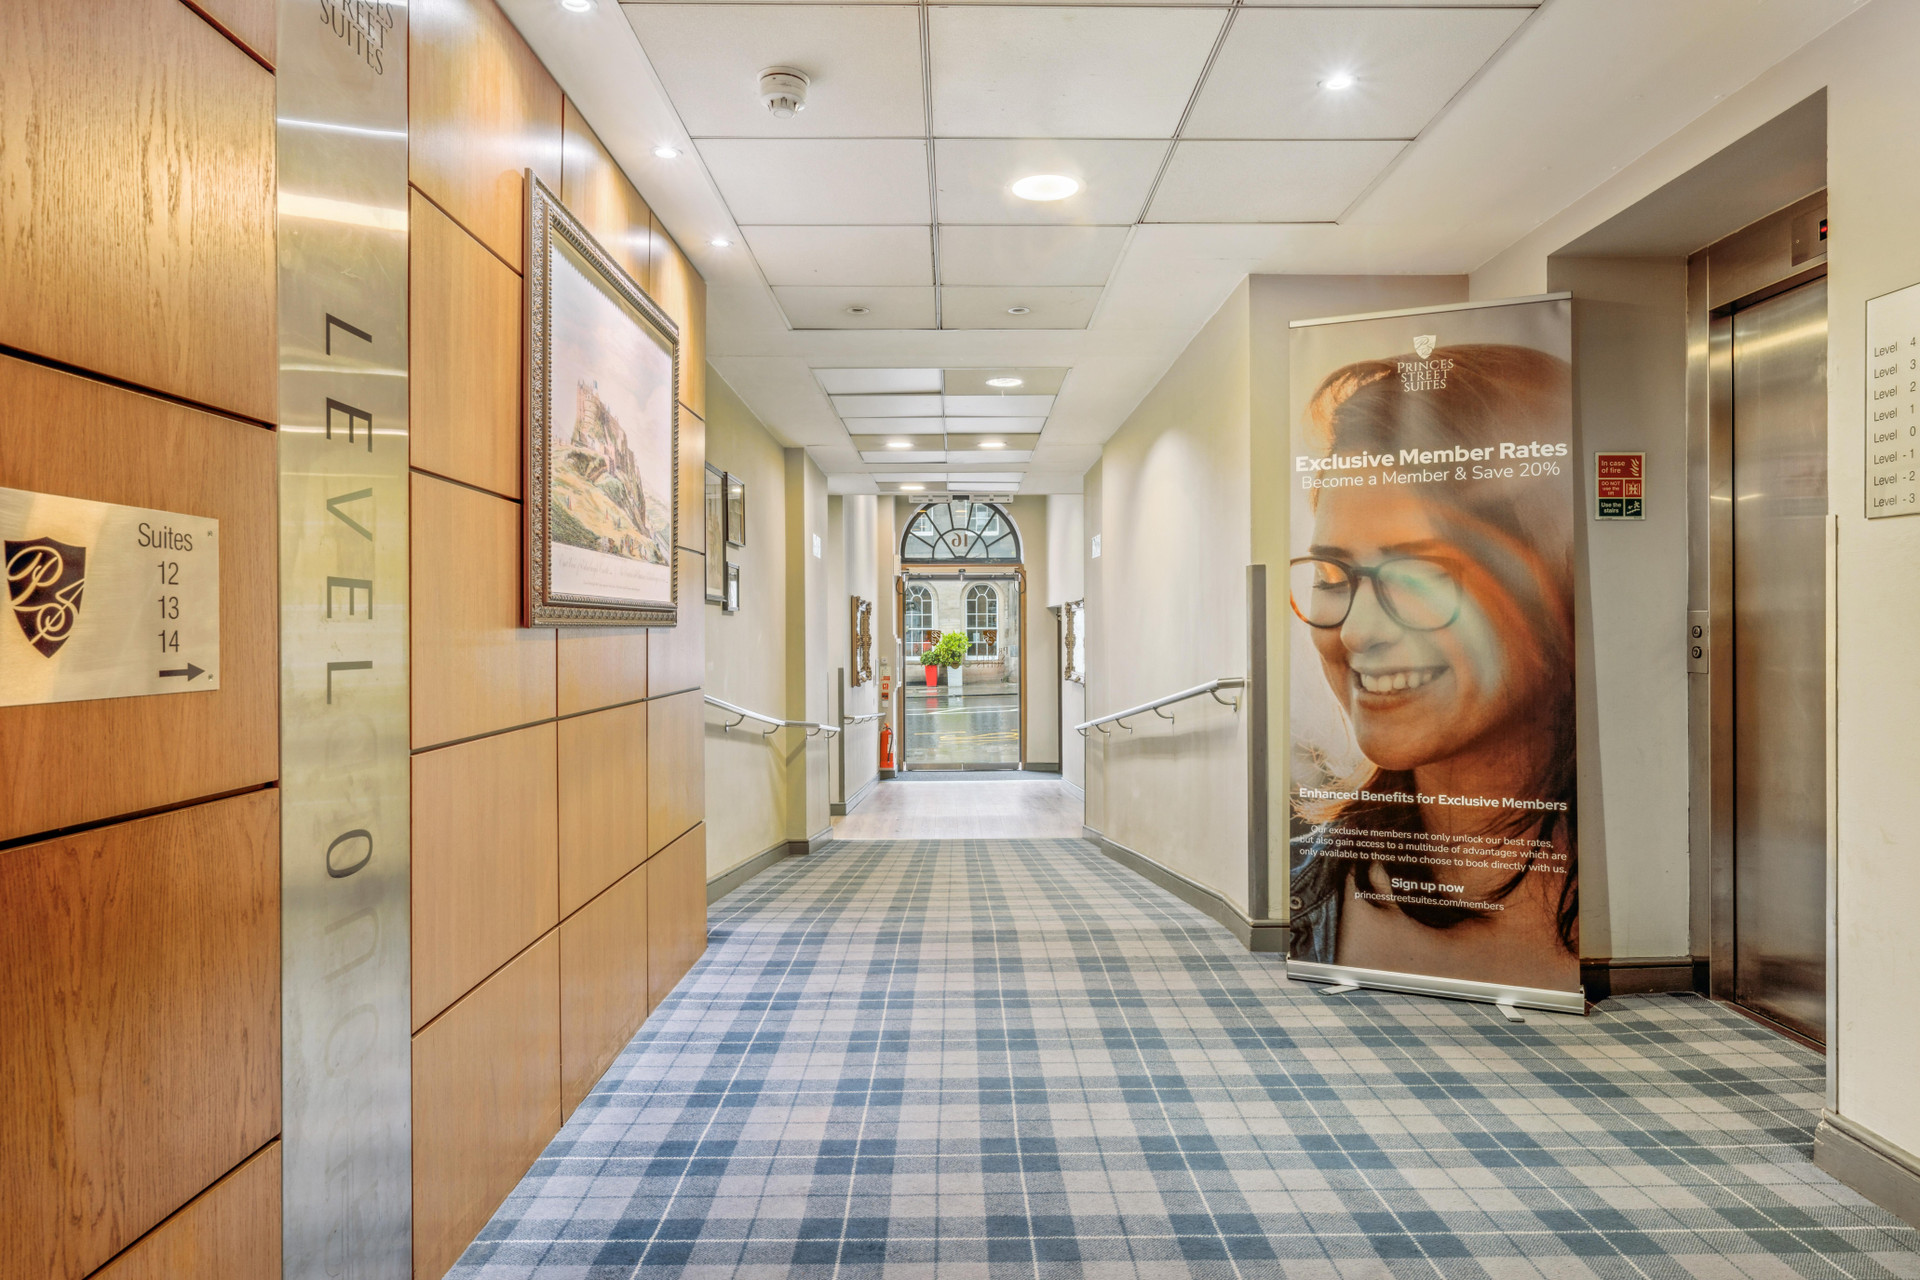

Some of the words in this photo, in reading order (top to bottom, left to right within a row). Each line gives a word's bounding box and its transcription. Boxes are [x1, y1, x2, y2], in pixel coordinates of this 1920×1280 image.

[320, 0, 383, 75] SUITES
[1873, 341, 1898, 358] Level
[1909, 336, 1916, 346] 4
[1397, 358, 1455, 374] PRINCES
[1400, 368, 1450, 383] STREET
[1873, 363, 1898, 379] Level
[1909, 358, 1917, 370] 3
[1403, 379, 1447, 393] SUITES
[1873, 385, 1898, 401] Level
[1909, 381, 1917, 393] 2
[1873, 407, 1898, 422] Level
[1909, 403, 1915, 414] 1
[1873, 429, 1898, 444] Level
[1909, 425, 1917, 437] 0
[1295, 451, 1395, 472] Exclusive
[1399, 445, 1494, 466] Member
[1499, 440, 1568, 460] Rates
[1873, 451, 1898, 465] Level
[1302, 475, 1364, 490] Become
[1368, 476, 1377, 486] a
[1382, 467, 1450, 485] Member
[1454, 466, 1467, 481] &
[1472, 464, 1514, 480] Save
[1519, 461, 1561, 477] 20%
[1873, 473, 1898, 487] Level
[326, 313, 373, 705] LEVEL
[1873, 494, 1898, 508] Level
[138, 522, 193, 552] Suites
[157, 561, 180, 586] 12
[157, 595, 180, 620] 13
[157, 629, 180, 654] 14
[1299, 788, 1359, 800] Enhanced
[1361, 790, 1414, 804] Benefits
[1416, 792, 1436, 804] for
[1438, 794, 1500, 808] Exclusive
[1502, 797, 1568, 811] Members
[1311, 825, 1327, 834] Our
[1329, 826, 1369, 836] exclusive
[1370, 829, 1412, 839] members
[1413, 832, 1428, 841] not
[1430, 833, 1451, 843] only
[1452, 834, 1483, 844] unlock
[1485, 837, 1502, 845] our
[1503, 837, 1525, 847] best
[1300, 836, 1314, 844] but
[1315, 836, 1333, 845] also
[1335, 838, 1354, 847] gain
[1356, 840, 1385, 849] access
[1386, 842, 1396, 850] to
[1405, 843, 1449, 853] multitude
[1451, 845, 1461, 853] of
[1462, 847, 1518, 858] advantages
[1519, 850, 1549, 860] which
[1551, 853, 1567, 861] are
[1299, 848, 1318, 857] only
[1319, 849, 1358, 859] available
[1359, 851, 1369, 860] to
[1370, 852, 1396, 861] those
[1397, 854, 1418, 863] who
[1419, 855, 1452, 866] choose
[1453, 859, 1464, 867] to
[1465, 858, 1489, 869] book
[1490, 860, 1527, 872] directly
[1528, 863, 1551, 873] with
[1552, 866, 1567, 874] us.
[1391, 878, 1418, 891] Sign
[1420, 881, 1437, 893] up
[1438, 884, 1465, 894] now
[1354, 891, 1505, 911] princesstreetsuites.com/members
